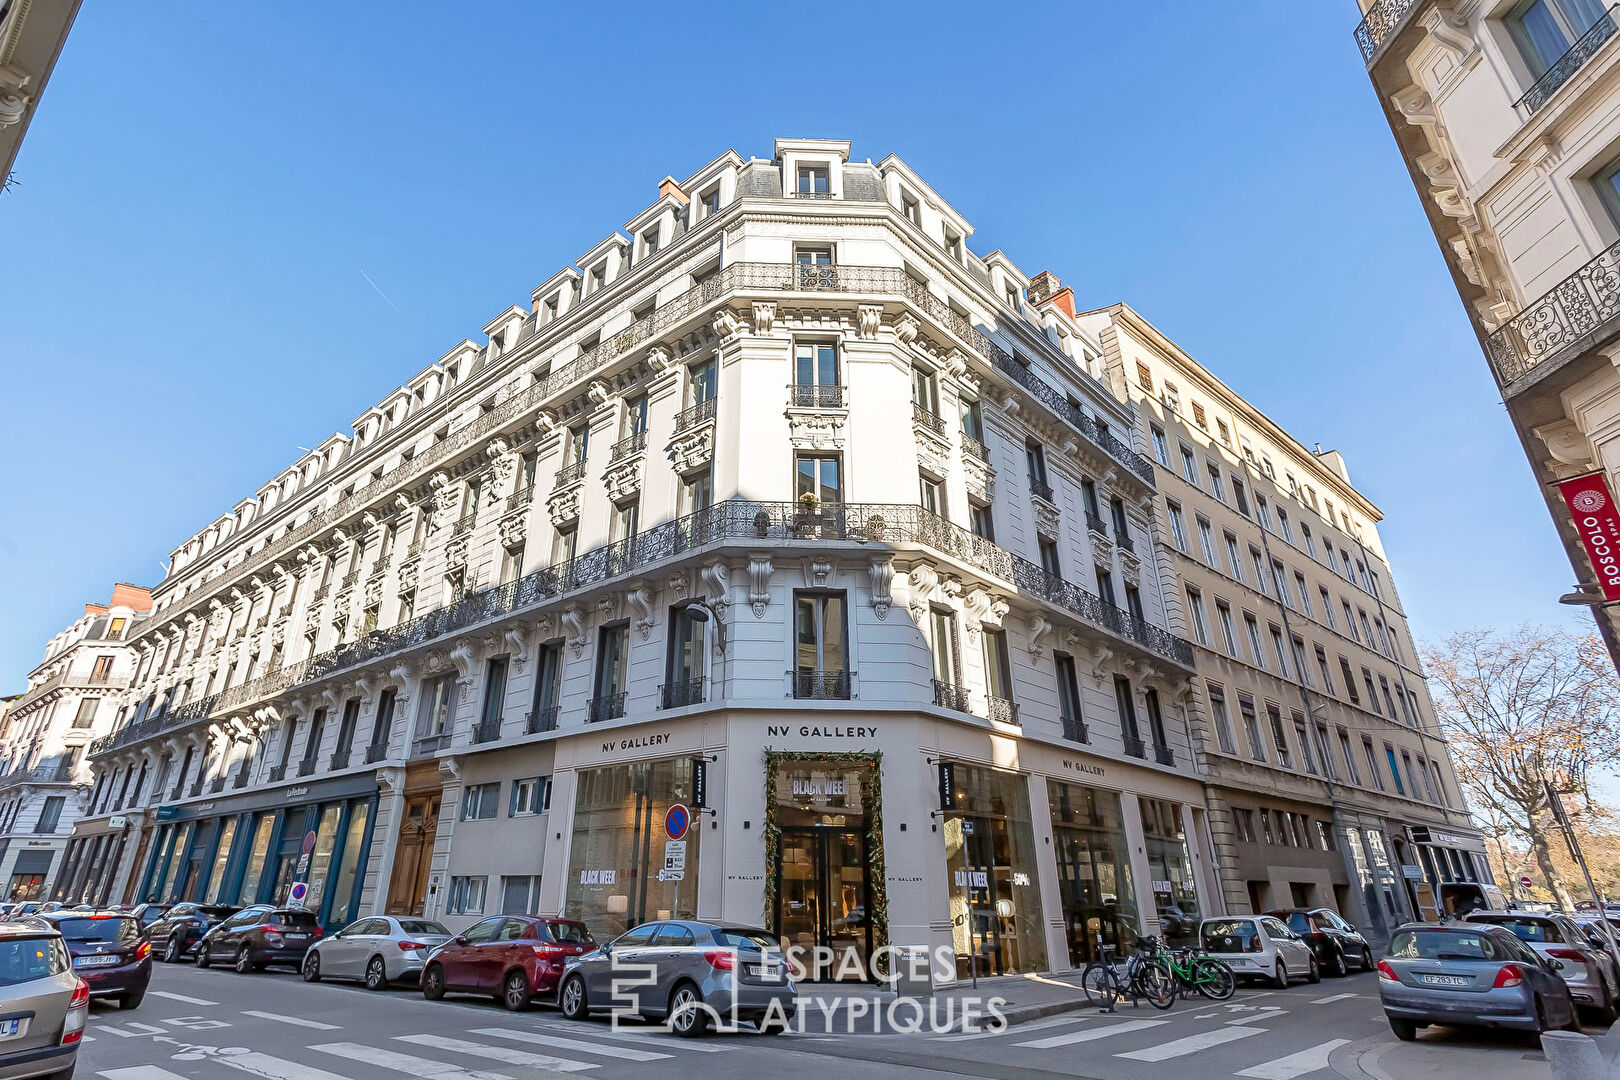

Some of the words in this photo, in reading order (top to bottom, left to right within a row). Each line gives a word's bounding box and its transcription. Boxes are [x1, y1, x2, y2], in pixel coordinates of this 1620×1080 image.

[1583, 516, 1620, 586] BOSCOLO
[767, 726, 790, 737] NV
[800, 726, 878, 738] GALLERY
[602, 741, 616, 753] NV
[620, 732, 671, 750] GALLERY
[1062, 759, 1074, 770] NV
[1075, 762, 1106, 777] GALLERY
[793, 780, 822, 795] BLACK
[580, 870, 599, 885] BLACK
[599, 870, 616, 885] WEEK
[954, 870, 973, 887] BLAK
